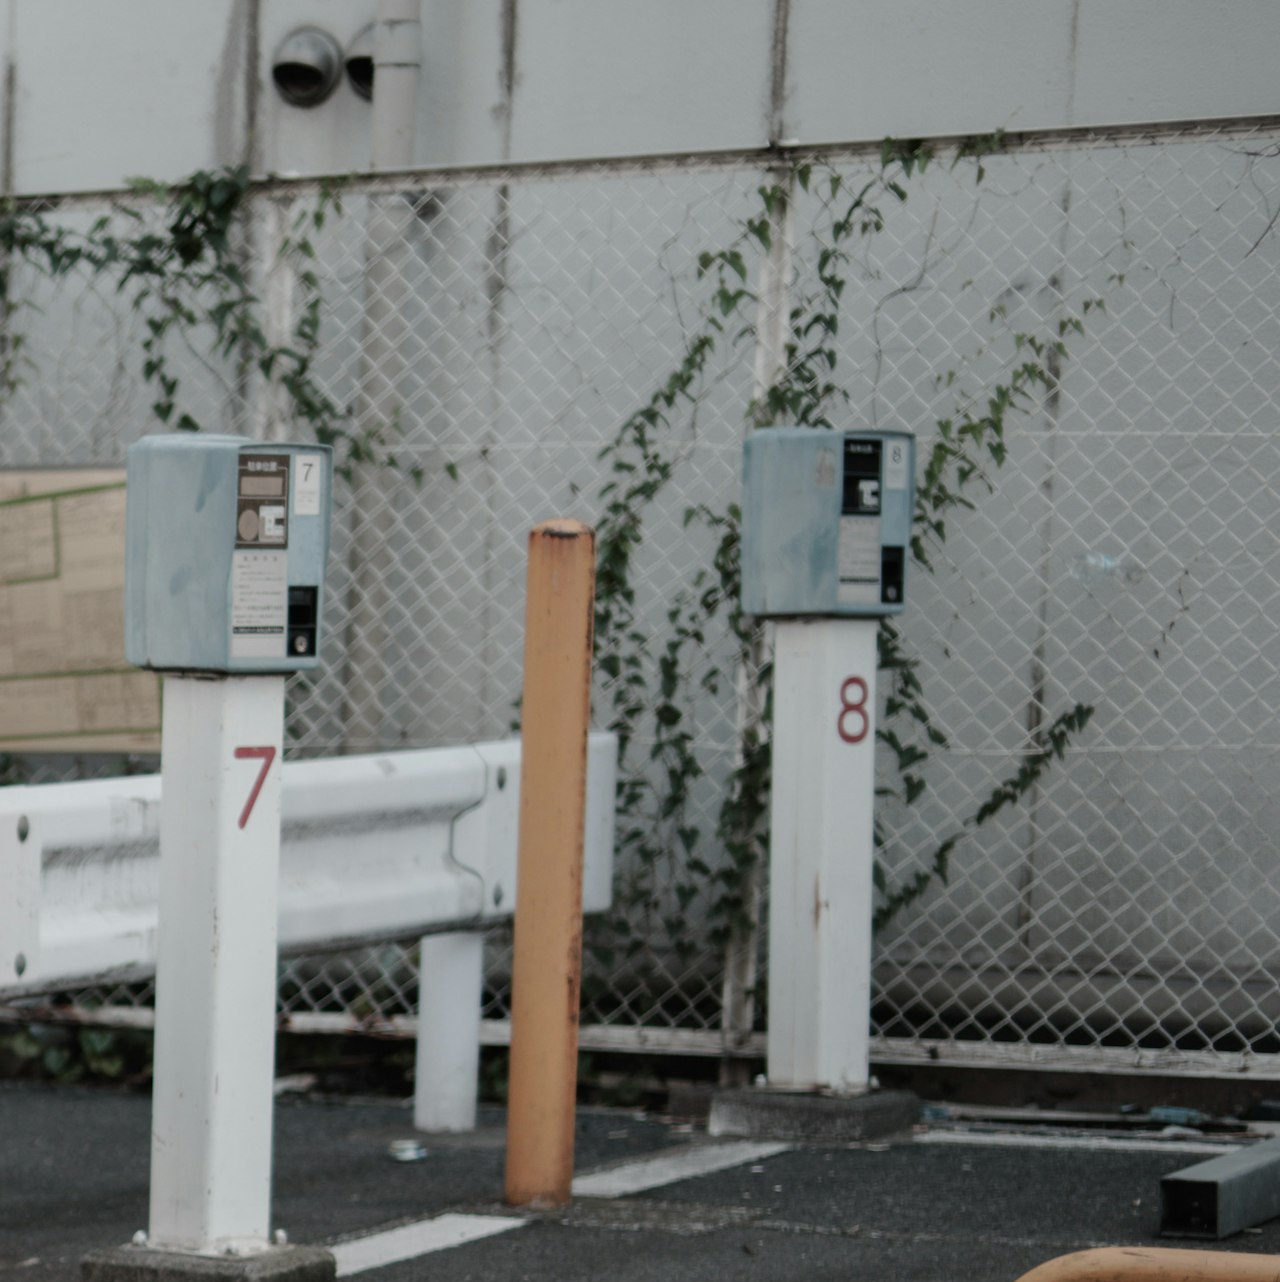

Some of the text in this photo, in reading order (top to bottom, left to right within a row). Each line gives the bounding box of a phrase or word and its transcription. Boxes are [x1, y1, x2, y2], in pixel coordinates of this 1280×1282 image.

[302, 463, 314, 482] 7
[838, 676, 869, 744] 8
[233, 746, 277, 830] 7
